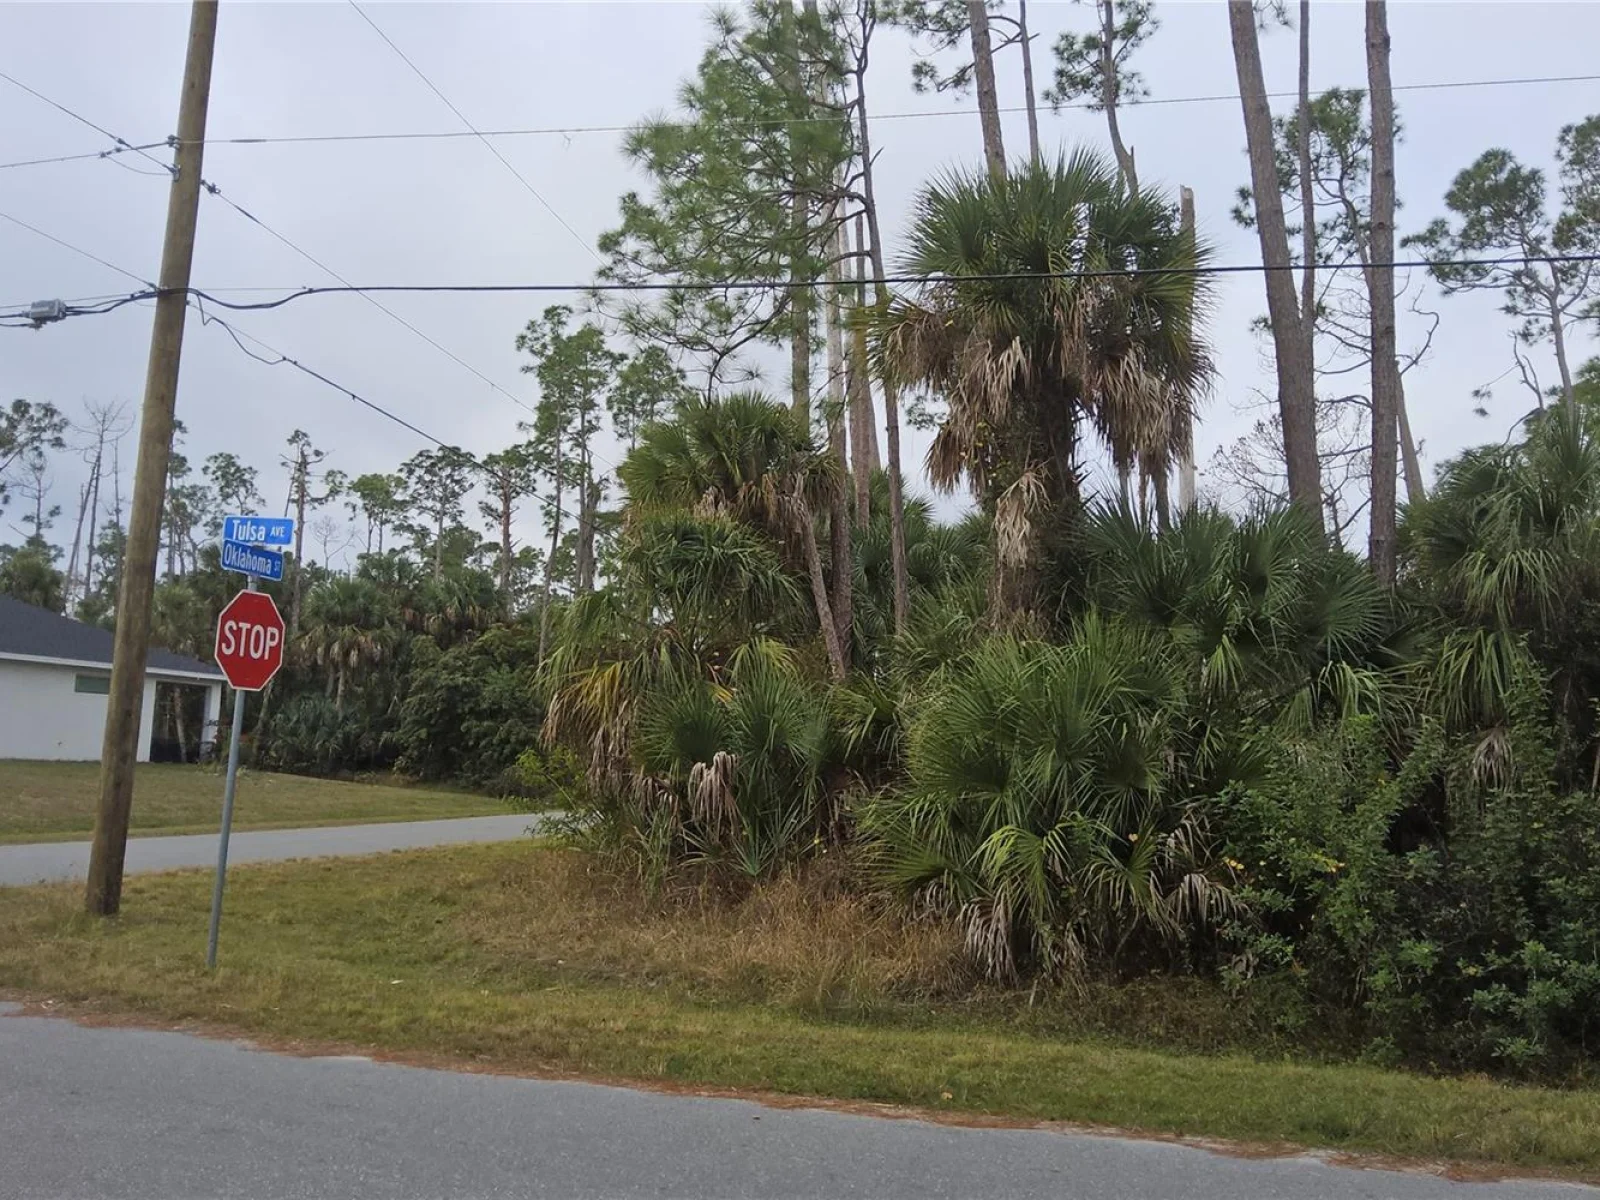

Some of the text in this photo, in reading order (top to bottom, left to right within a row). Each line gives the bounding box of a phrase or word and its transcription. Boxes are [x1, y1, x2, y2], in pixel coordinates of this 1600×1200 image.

[232, 519, 286, 541] Tulsa AVE
[224, 543, 282, 575] Oklahoma ST
[221, 620, 279, 660] STOP
